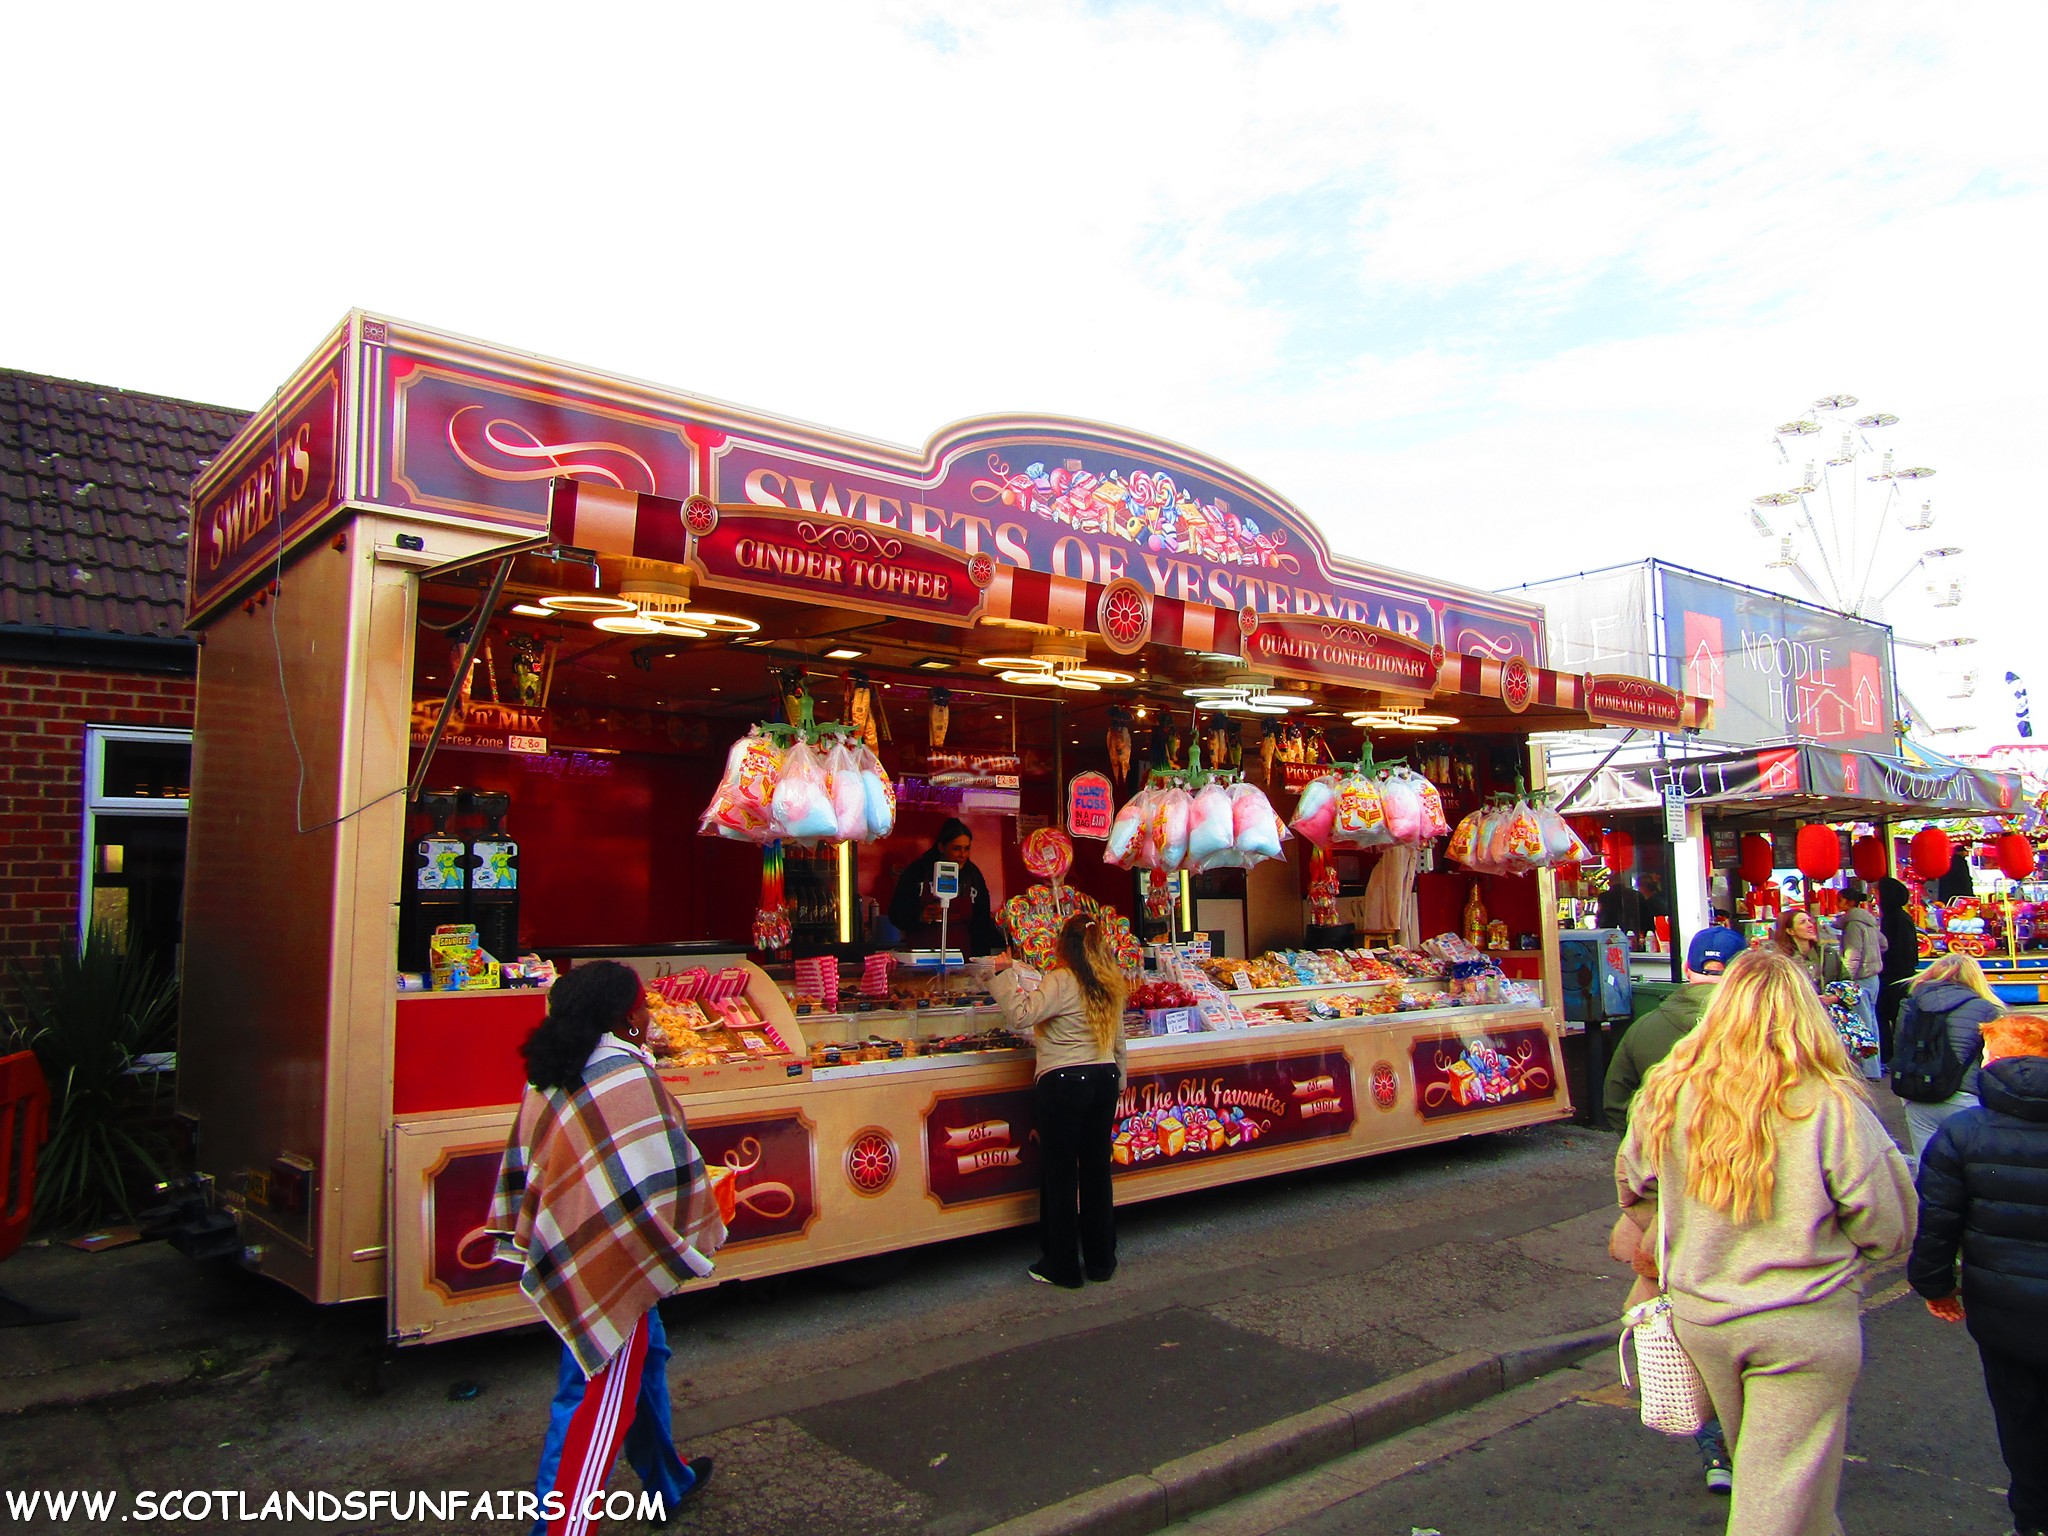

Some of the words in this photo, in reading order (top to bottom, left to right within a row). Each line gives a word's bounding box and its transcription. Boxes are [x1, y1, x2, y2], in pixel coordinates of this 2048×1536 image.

[210, 422, 310, 571] SWEETS
[744, 468, 1031, 569] SWEETS
[1052, 535, 1129, 588] OF
[735, 538, 843, 583] CINDER
[850, 559, 949, 600] TOFFEE
[1259, 631, 1321, 661] QUALITY
[1323, 642, 1427, 678] CONFECTIONARY
[1741, 628, 1836, 688] NOODLE
[1594, 693, 1646, 716] HOMEMADE
[1647, 701, 1676, 720] FUDGE
[1768, 678, 1815, 724] HUT
[498, 709, 543, 733] Mix
[475, 736, 504, 748] Zone
[932, 751, 966, 768] Pick
[1286, 765, 1310, 780] Pick
[1884, 766, 1947, 800] NOODLE
[1077, 785, 1105, 798] CANDY
[1075, 798, 1107, 810] FLOSS
[1076, 819, 1090, 827] BAG
[1141, 1082, 1174, 1109] The
[1177, 1077, 1207, 1106] Old
[1211, 1077, 1287, 1117] Favourites
[1310, 1100, 1334, 1114] 1960
[968, 1123, 992, 1141] est.
[973, 1150, 1009, 1168] 1960
